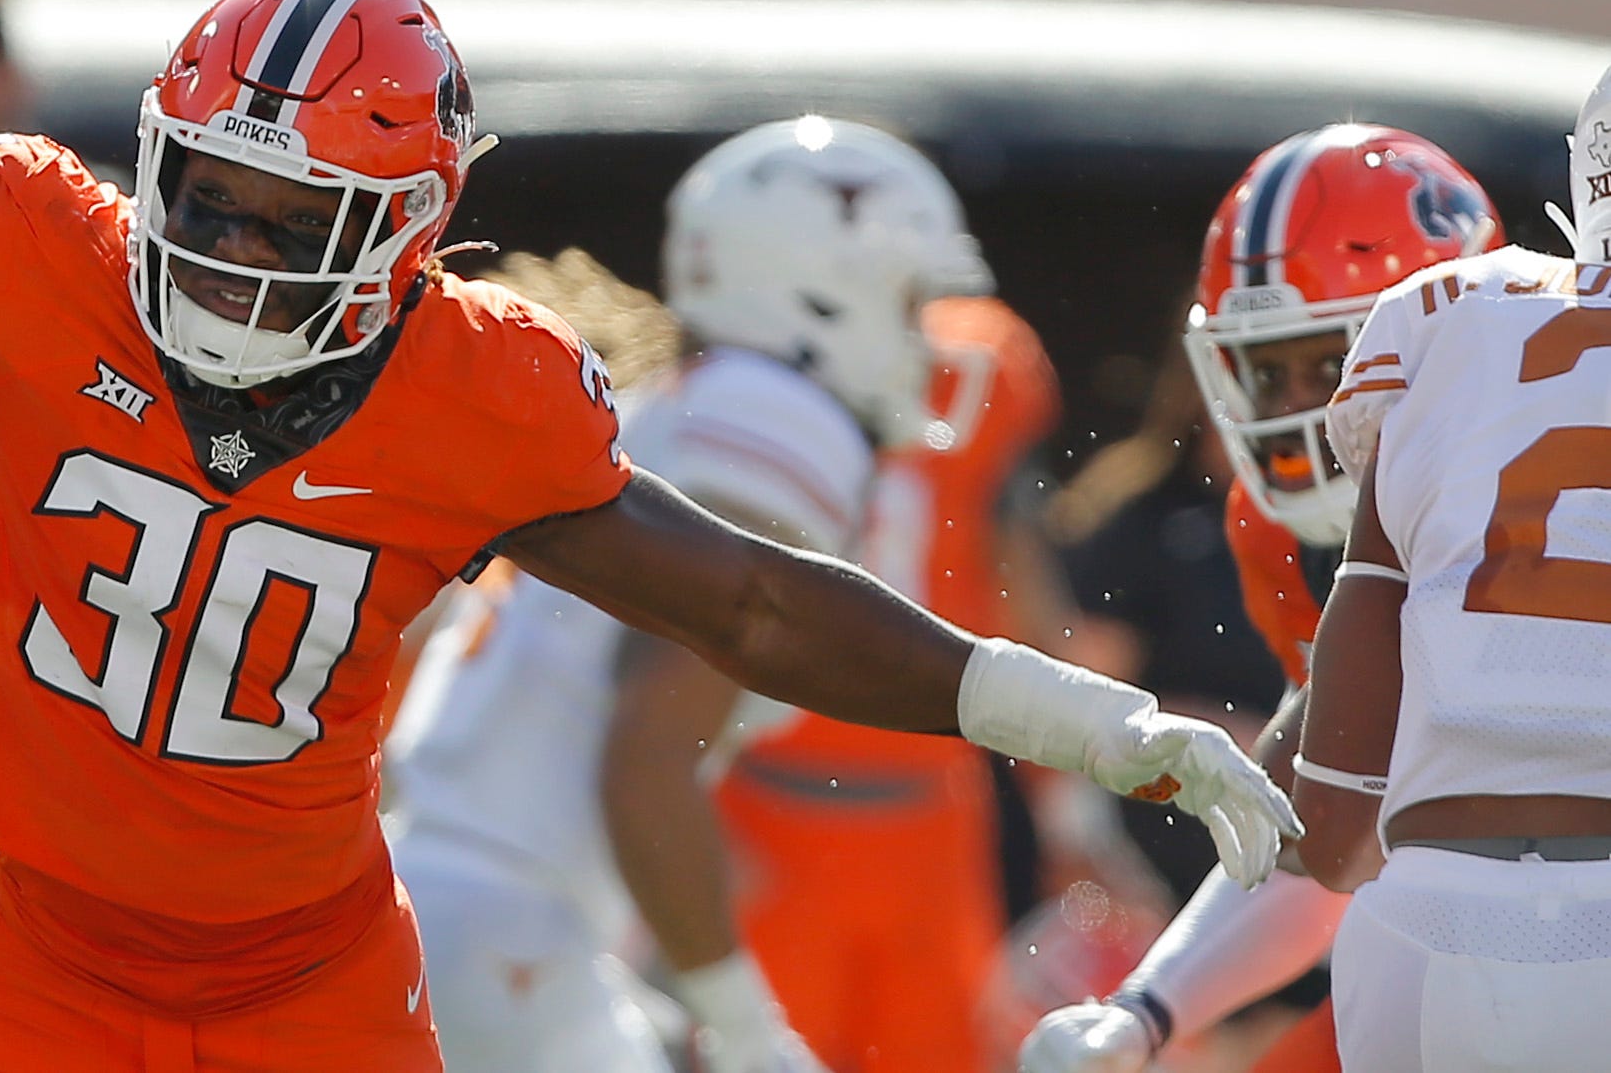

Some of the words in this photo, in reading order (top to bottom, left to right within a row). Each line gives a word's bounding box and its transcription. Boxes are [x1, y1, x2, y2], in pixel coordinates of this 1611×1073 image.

[224, 115, 291, 151] POKES
[1586, 172, 1611, 206] XI
[76, 354, 158, 424] XII
[17, 447, 381, 767] 30
